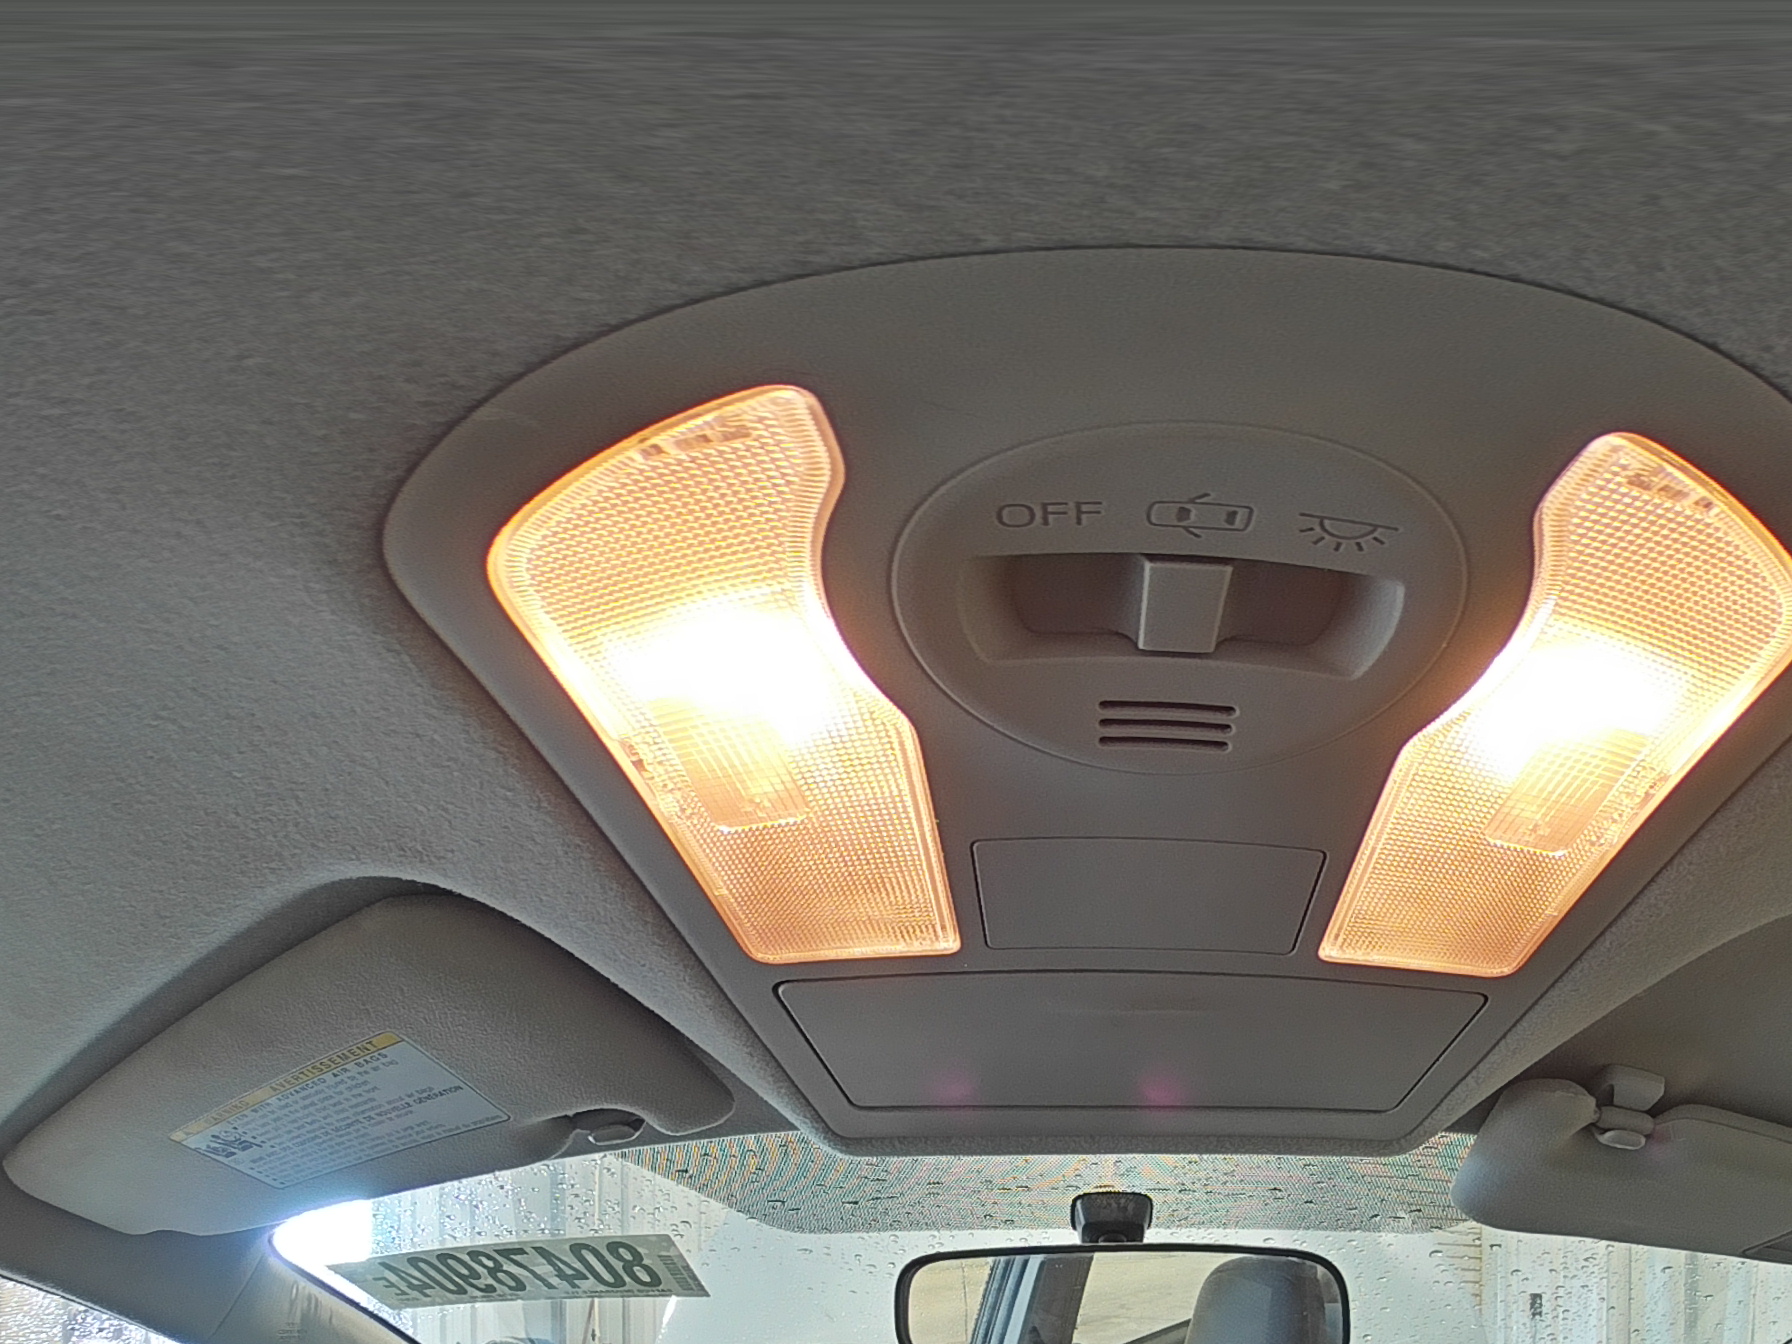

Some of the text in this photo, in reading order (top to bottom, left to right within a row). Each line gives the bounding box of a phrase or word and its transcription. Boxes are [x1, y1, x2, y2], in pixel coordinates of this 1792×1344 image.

[996, 501, 1102, 528] OFF
[269, 1040, 378, 1092] AVERTISSEMENT
[354, 1052, 388, 1068] BAGS
